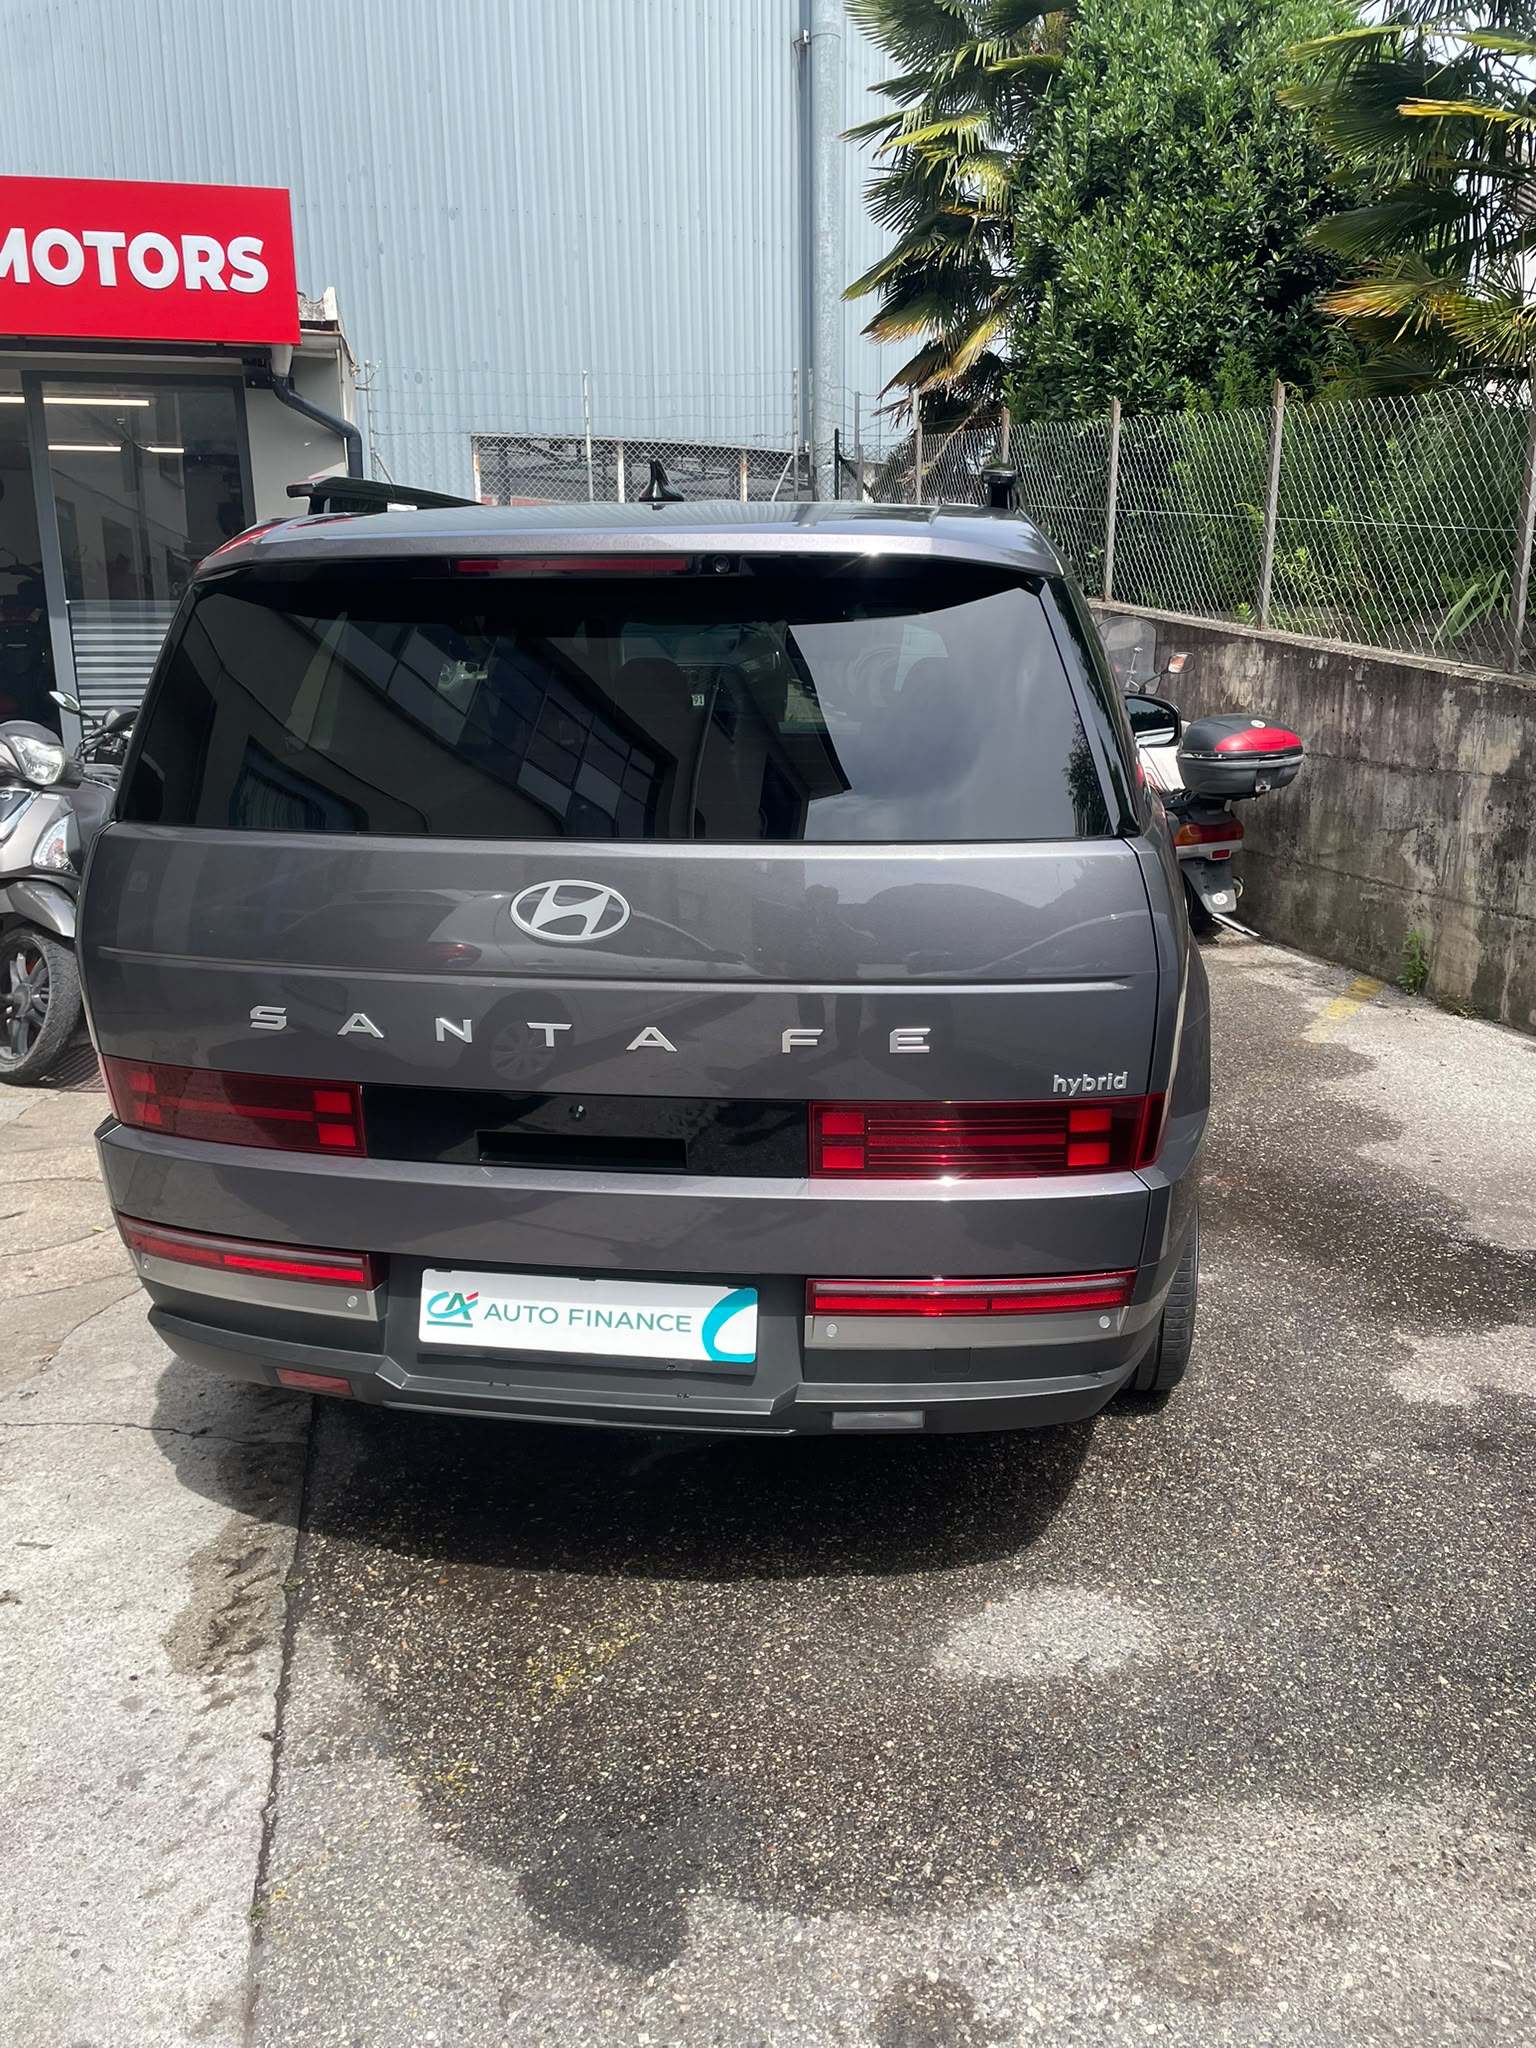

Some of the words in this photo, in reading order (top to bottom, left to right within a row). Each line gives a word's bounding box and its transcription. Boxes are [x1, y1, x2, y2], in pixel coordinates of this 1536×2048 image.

[0, 227, 269, 293] MOTORS
[249, 1004, 677, 1053] SANTA
[781, 1027, 931, 1054] FE
[1052, 1071, 1129, 1097] hybrid
[483, 1303, 559, 1325] AUTO
[568, 1308, 693, 1333] FINANCE
